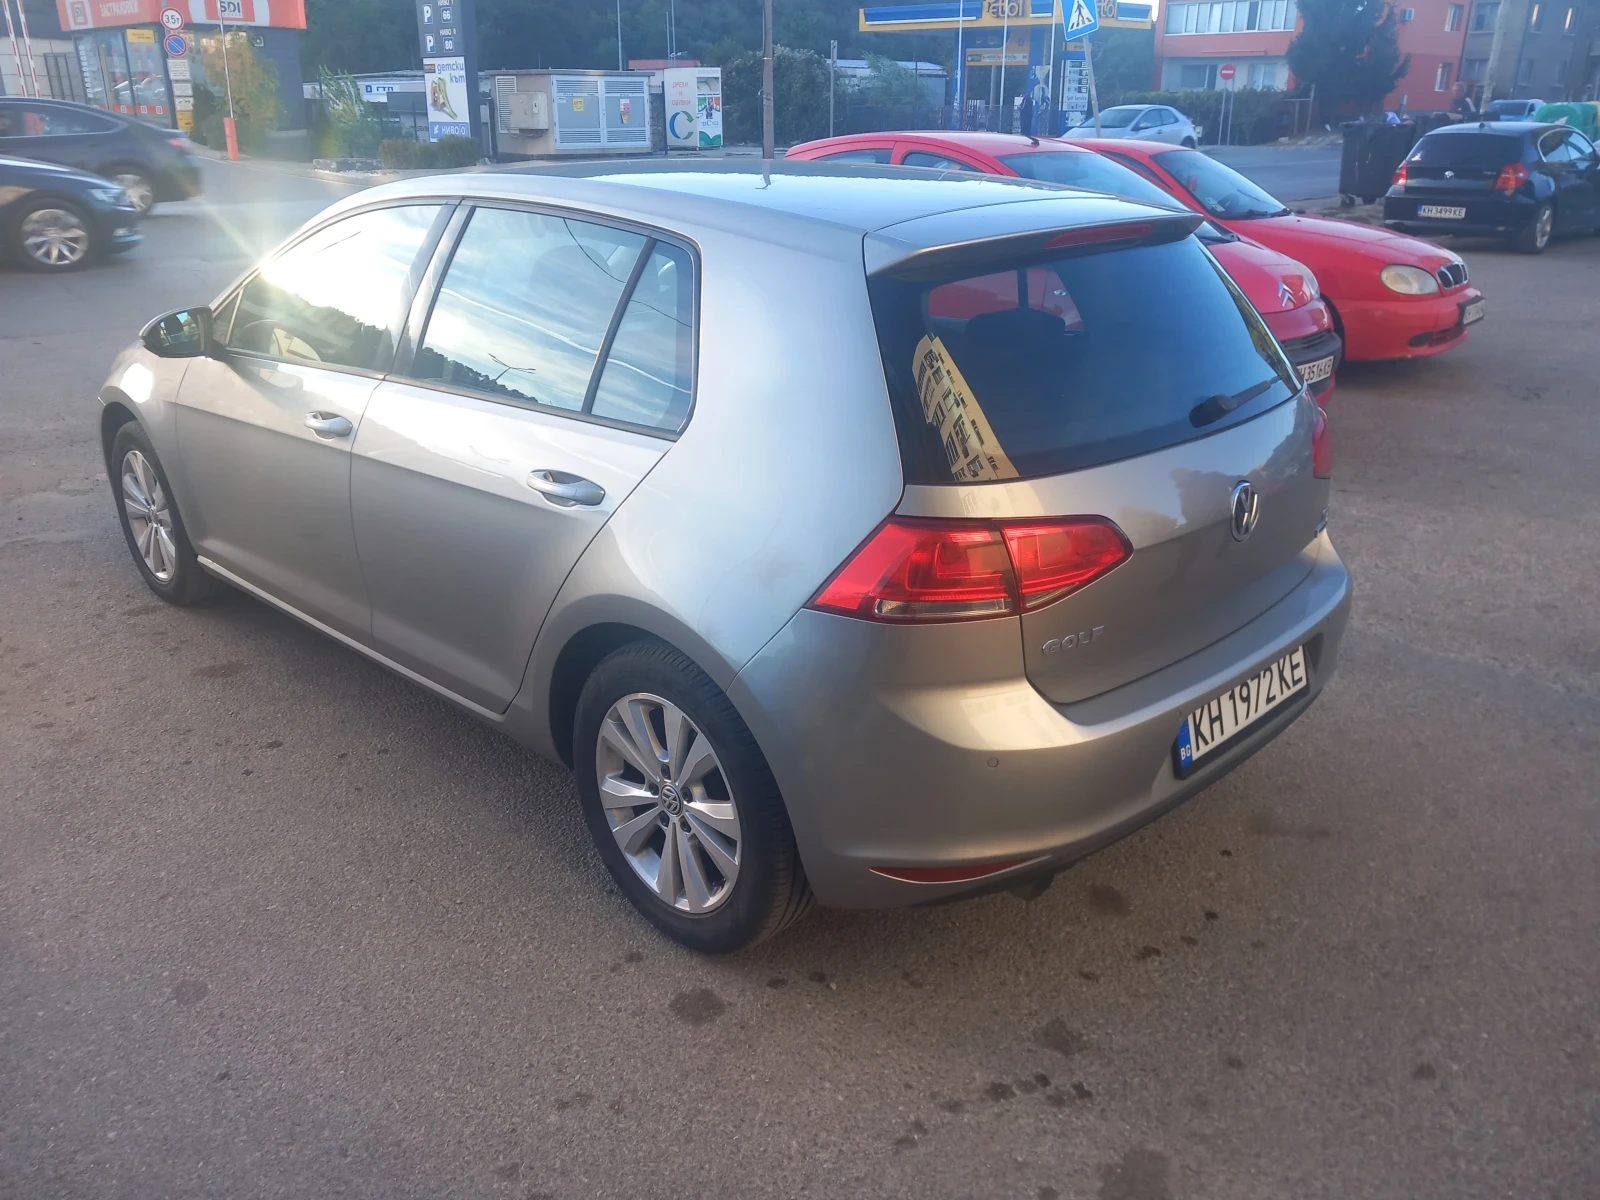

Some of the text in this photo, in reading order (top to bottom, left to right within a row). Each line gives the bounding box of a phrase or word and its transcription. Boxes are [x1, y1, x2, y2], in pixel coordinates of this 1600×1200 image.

[220, 1, 241, 14] SDI
[423, 5, 431, 23] P
[442, 10, 451, 20] 66
[426, 35, 434, 52] P
[441, 126, 460, 135] НИВО
[1042, 626, 1104, 655] GOLF
[1180, 744, 1191, 761] BG
